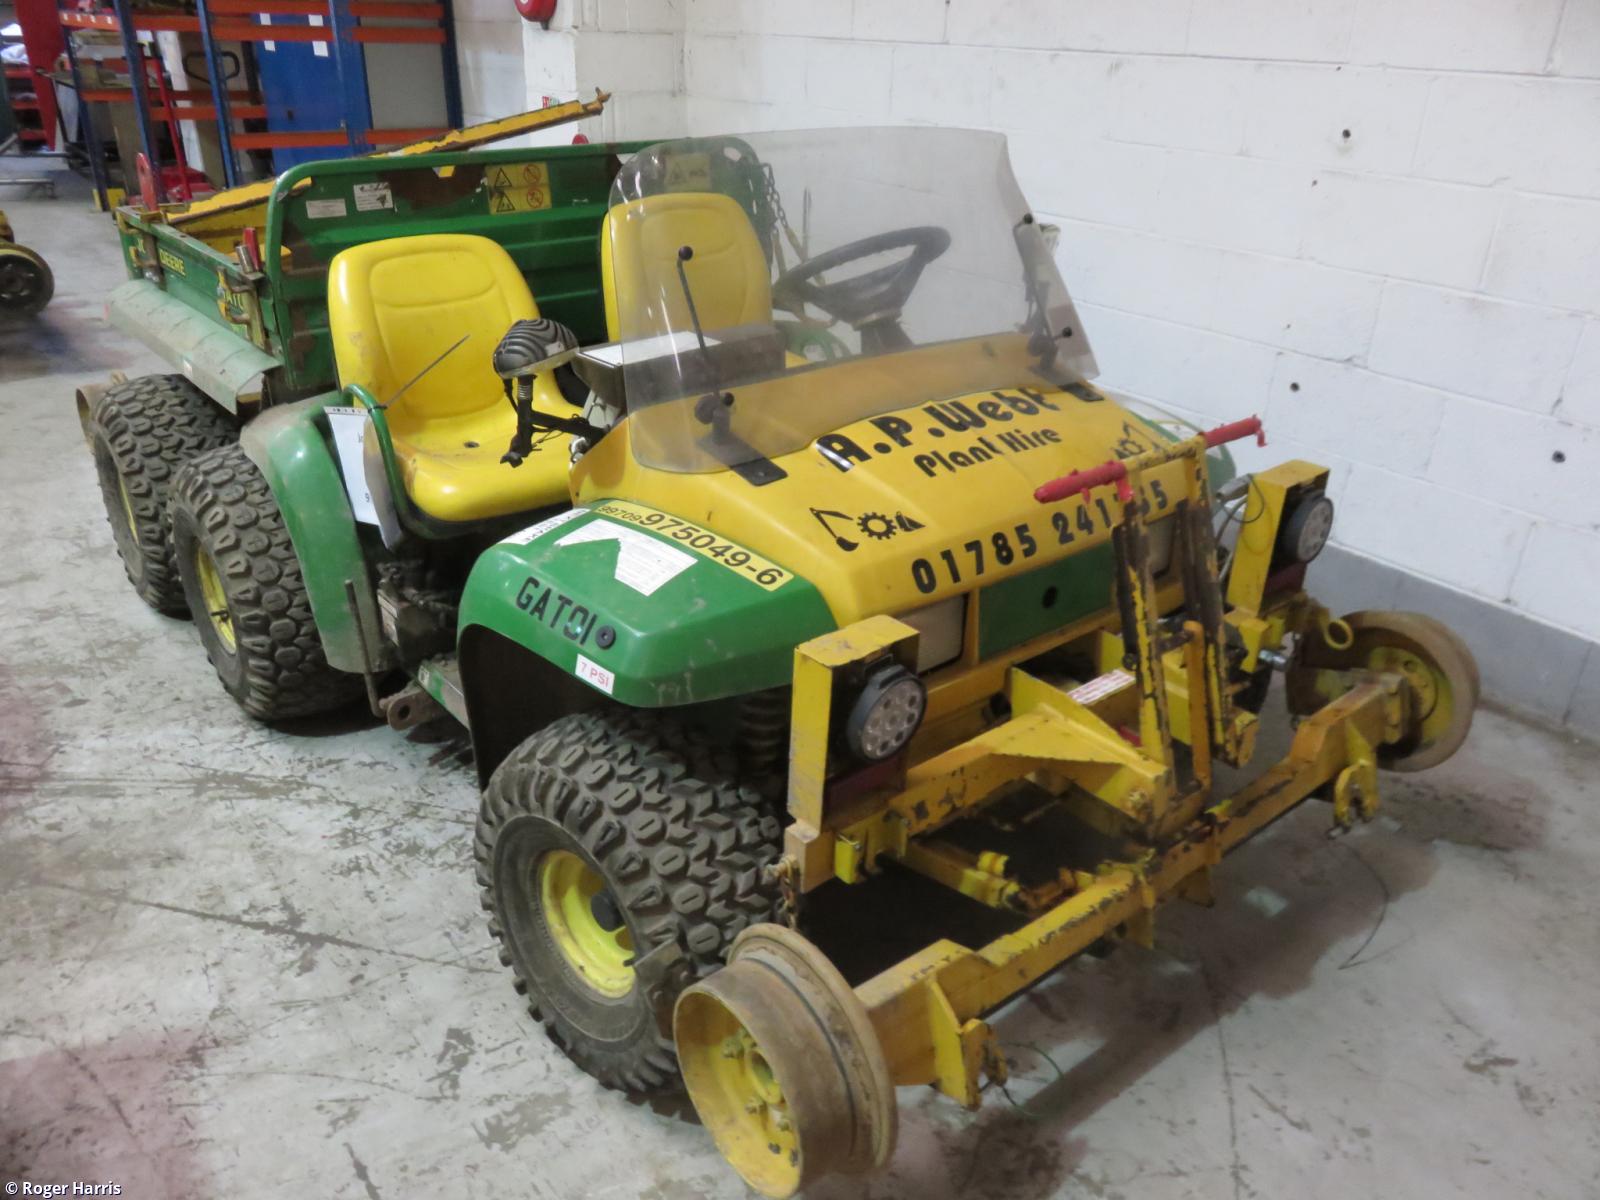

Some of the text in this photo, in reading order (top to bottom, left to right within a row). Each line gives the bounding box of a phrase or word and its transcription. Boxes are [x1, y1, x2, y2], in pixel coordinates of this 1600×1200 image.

[914, 428, 1062, 478] Plant Hire
[639, 513, 784, 585] 975049-6
[911, 479, 1168, 594] 01785 2415
[580, 662, 587, 673] 7
